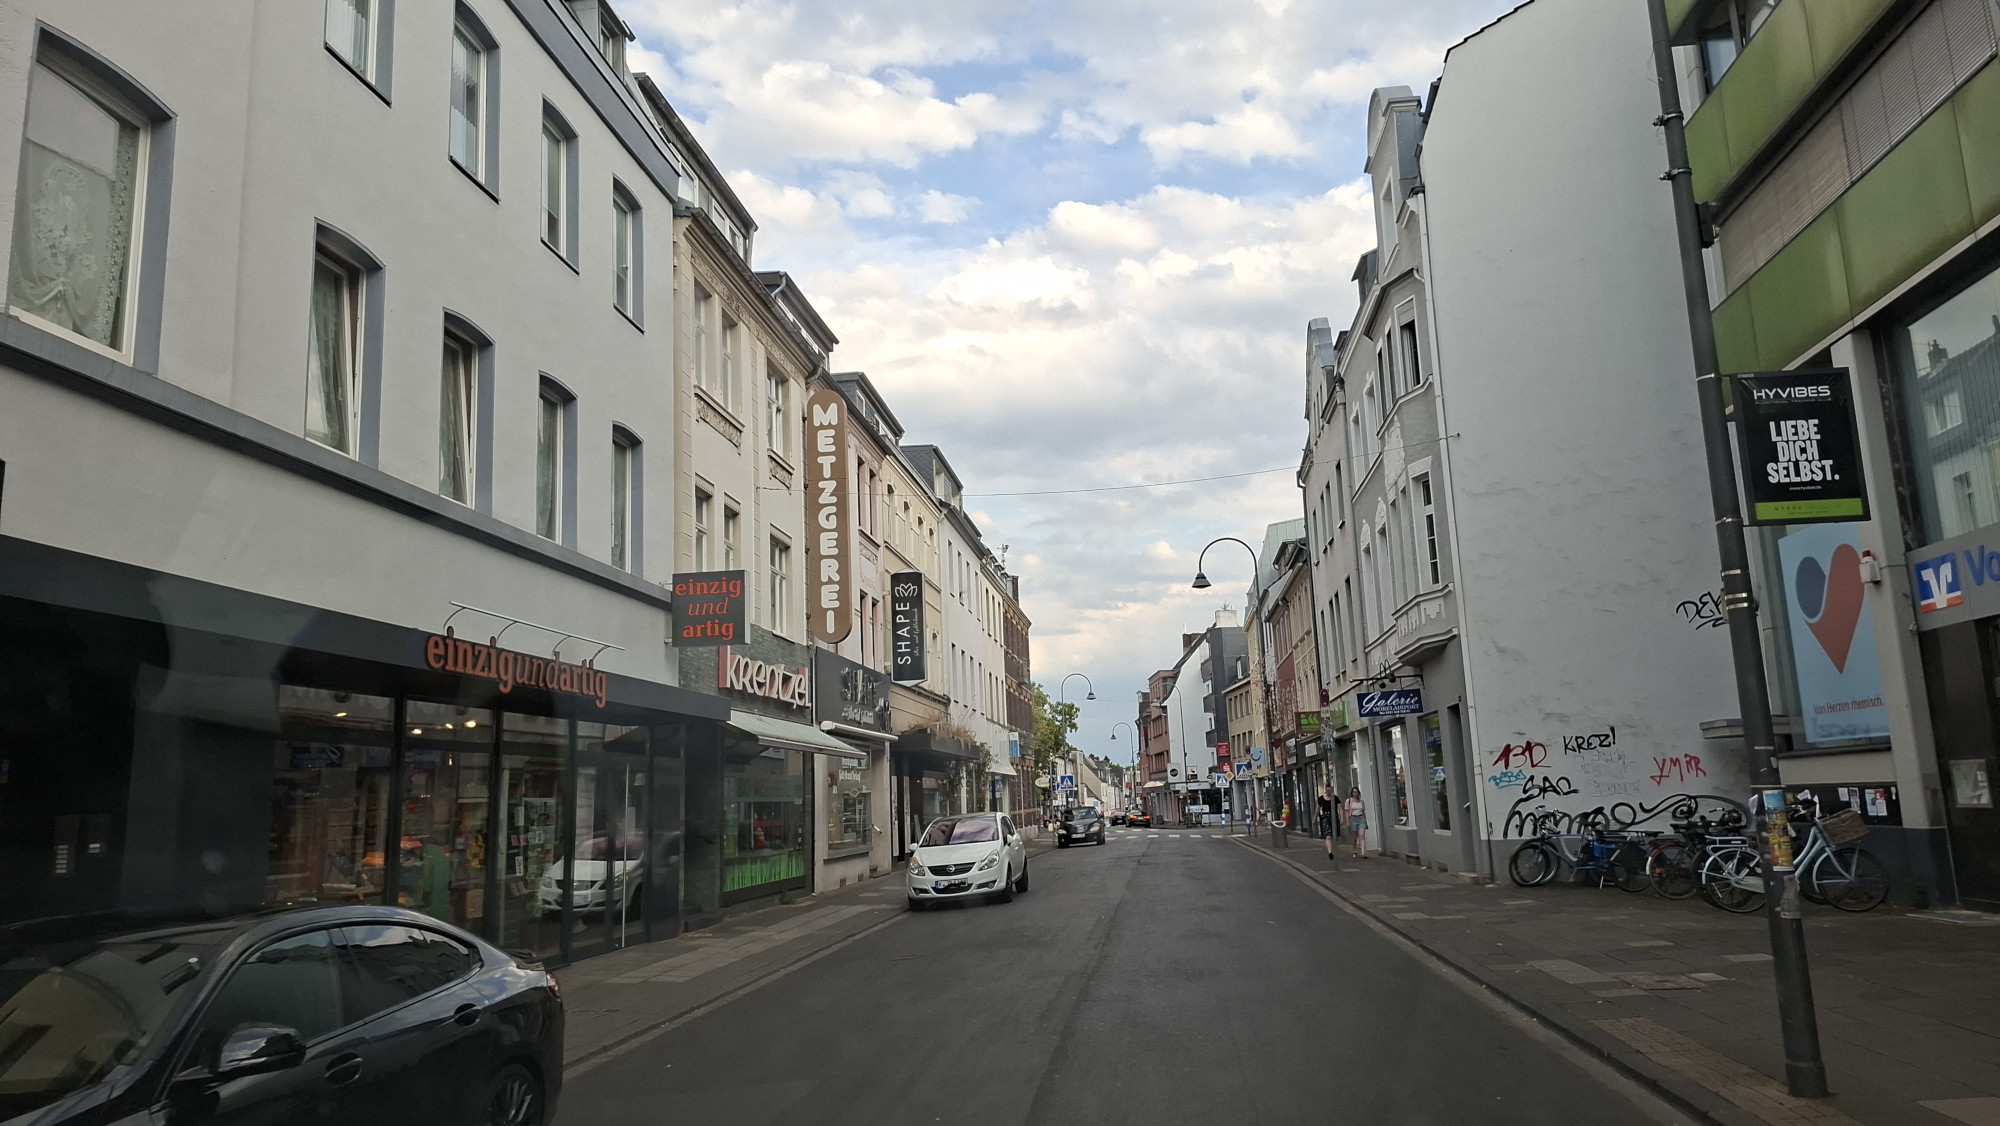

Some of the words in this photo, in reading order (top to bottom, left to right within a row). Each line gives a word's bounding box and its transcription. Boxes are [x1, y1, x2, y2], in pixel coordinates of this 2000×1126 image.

[1753, 385, 1831, 400] HYVIBES
[1769, 419, 1821, 441] LIEBE
[1776, 440, 1820, 462] DICH
[1766, 459, 1840, 484] SELBST.
[812, 402, 840, 634] METZGEREI
[675, 576, 742, 598] einzig
[688, 597, 729, 616] und
[682, 619, 735, 640] artig
[895, 602, 911, 665] SHAPE
[427, 626, 607, 708] einzigundartig
[1361, 691, 1418, 714] Galerie
